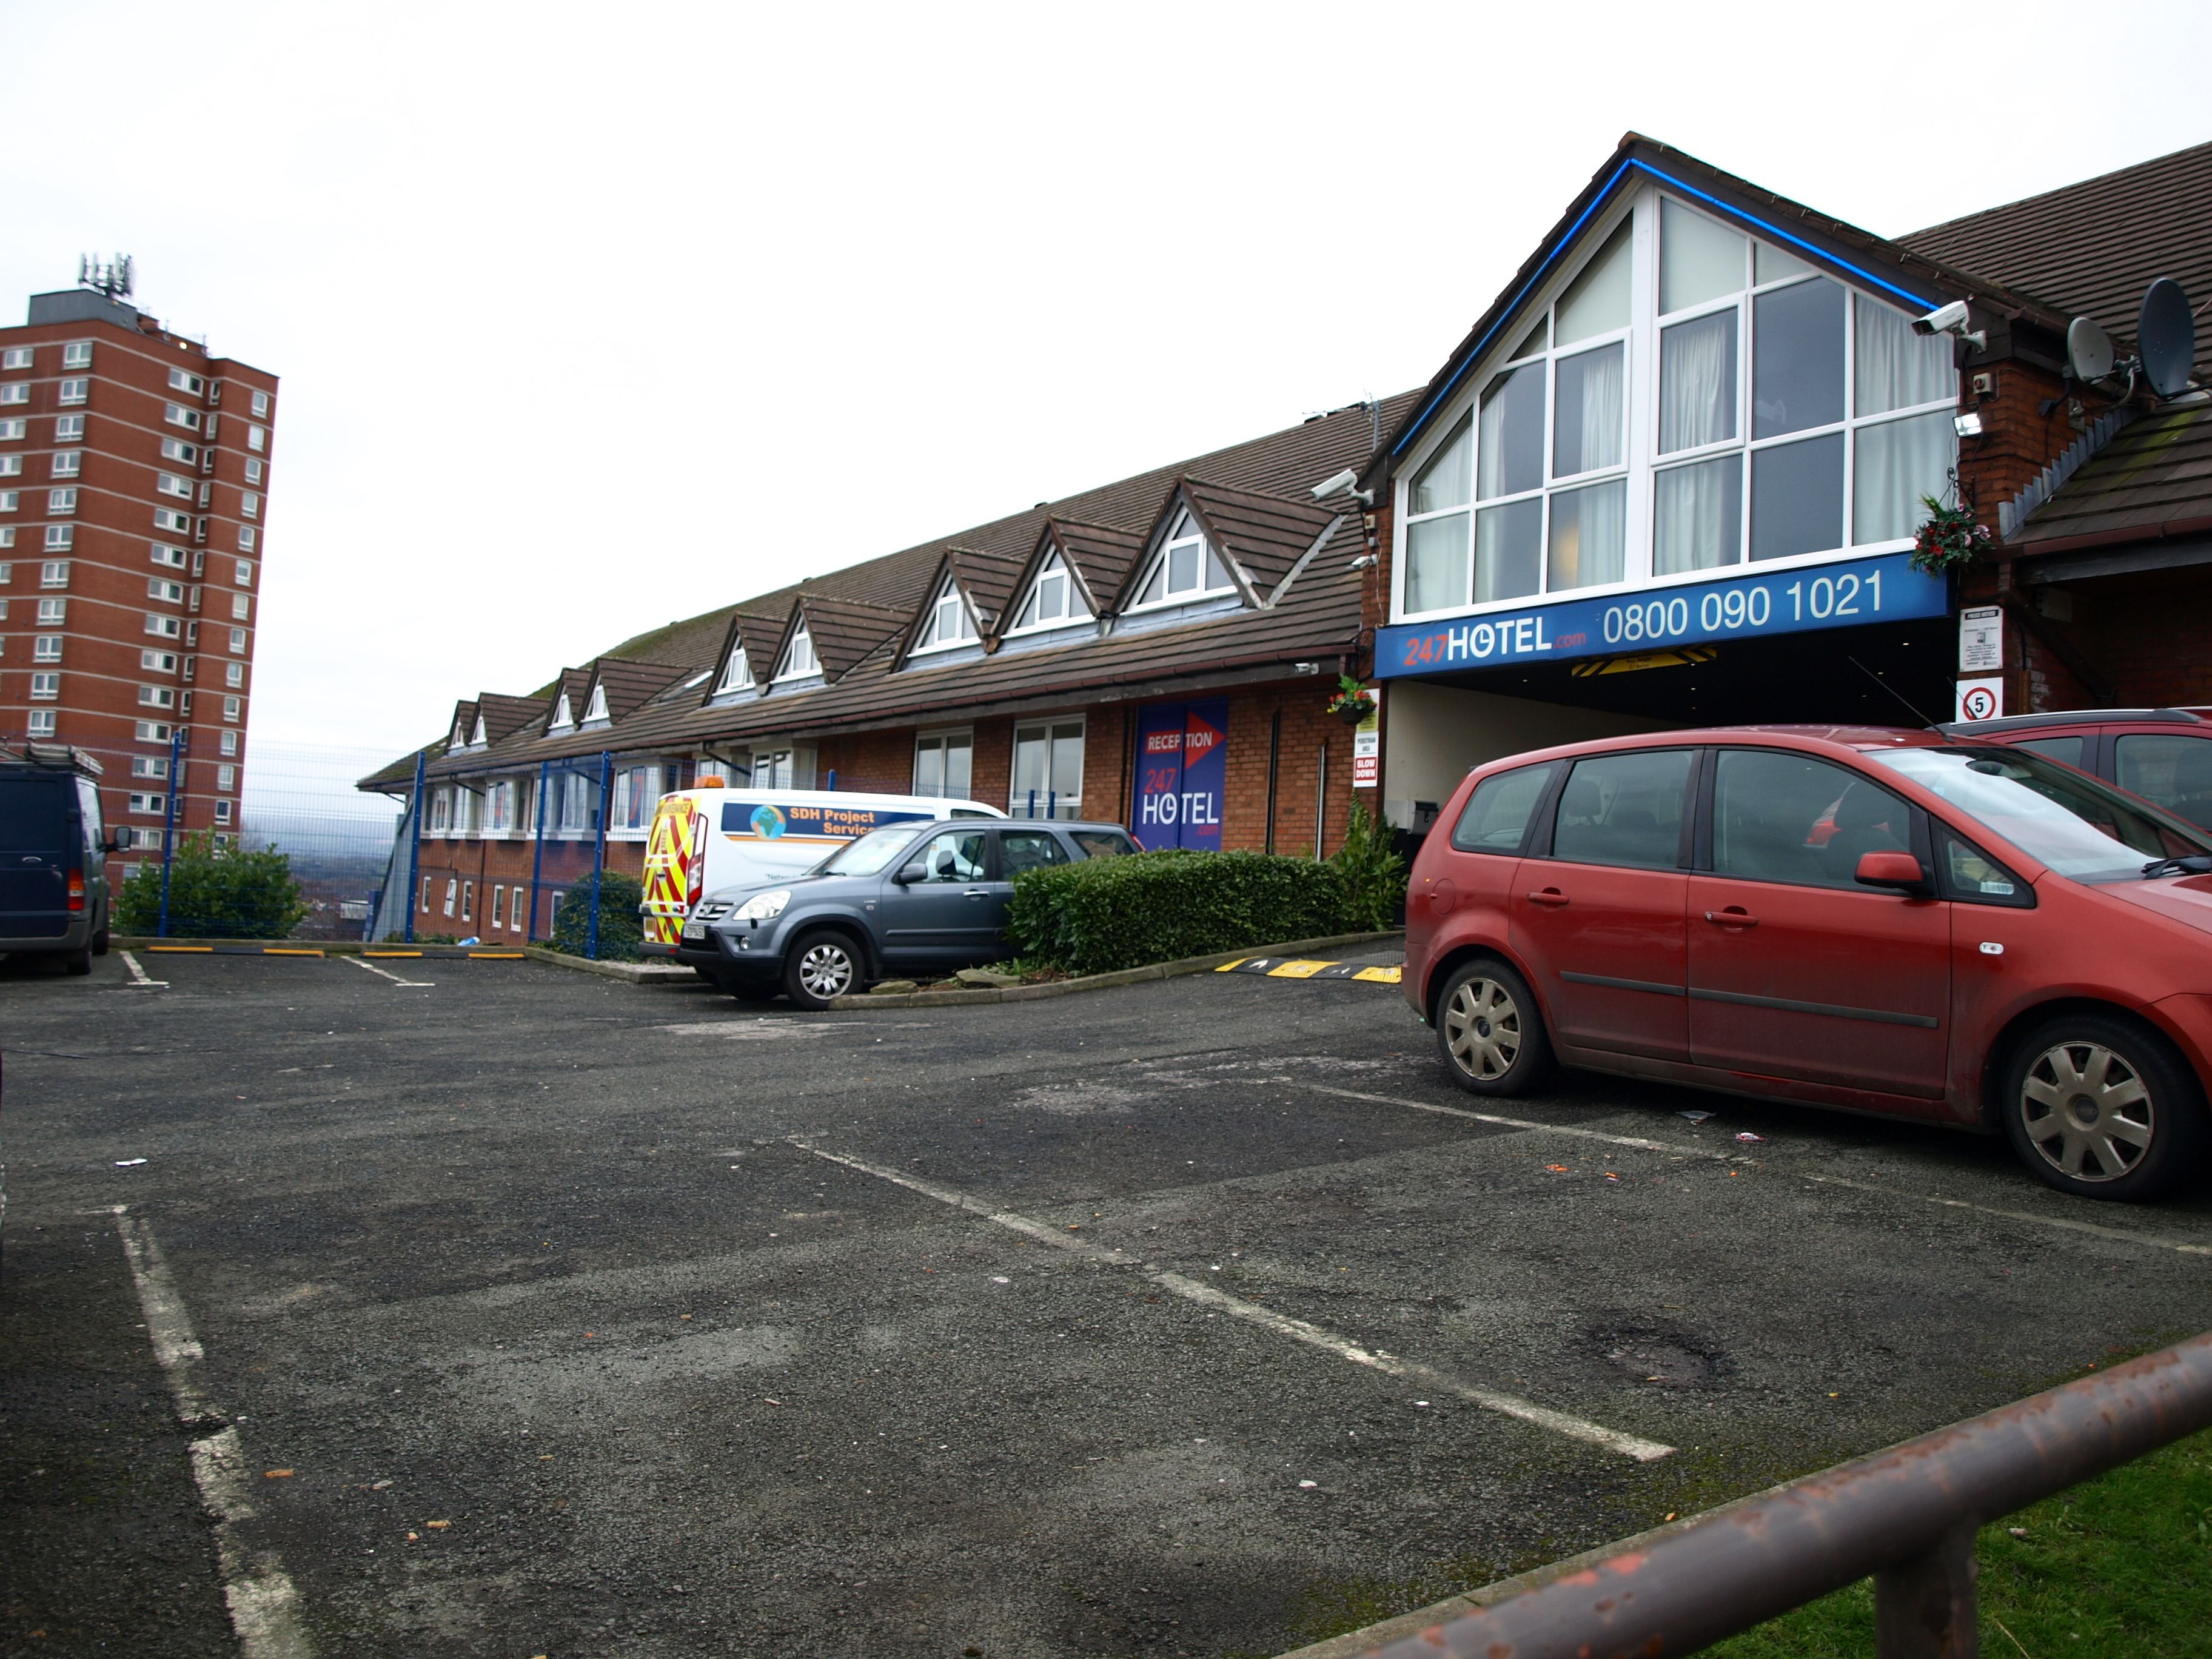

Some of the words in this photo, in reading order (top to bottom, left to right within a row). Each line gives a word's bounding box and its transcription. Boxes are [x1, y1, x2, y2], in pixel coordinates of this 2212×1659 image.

[1603, 597, 1689, 643] 0800
[1701, 586, 1771, 632] 090
[1786, 569, 1880, 622] 1021
[1975, 697, 1984, 713] 5
[1148, 731, 1213, 751] RECEPTION
[1356, 759, 1376, 768] SLOW
[1144, 768, 1177, 794] 247
[1356, 769, 1375, 779] DOWN
[789, 807, 820, 820] SDH
[824, 809, 875, 825] Project
[1142, 792, 1219, 825] HOTEL
